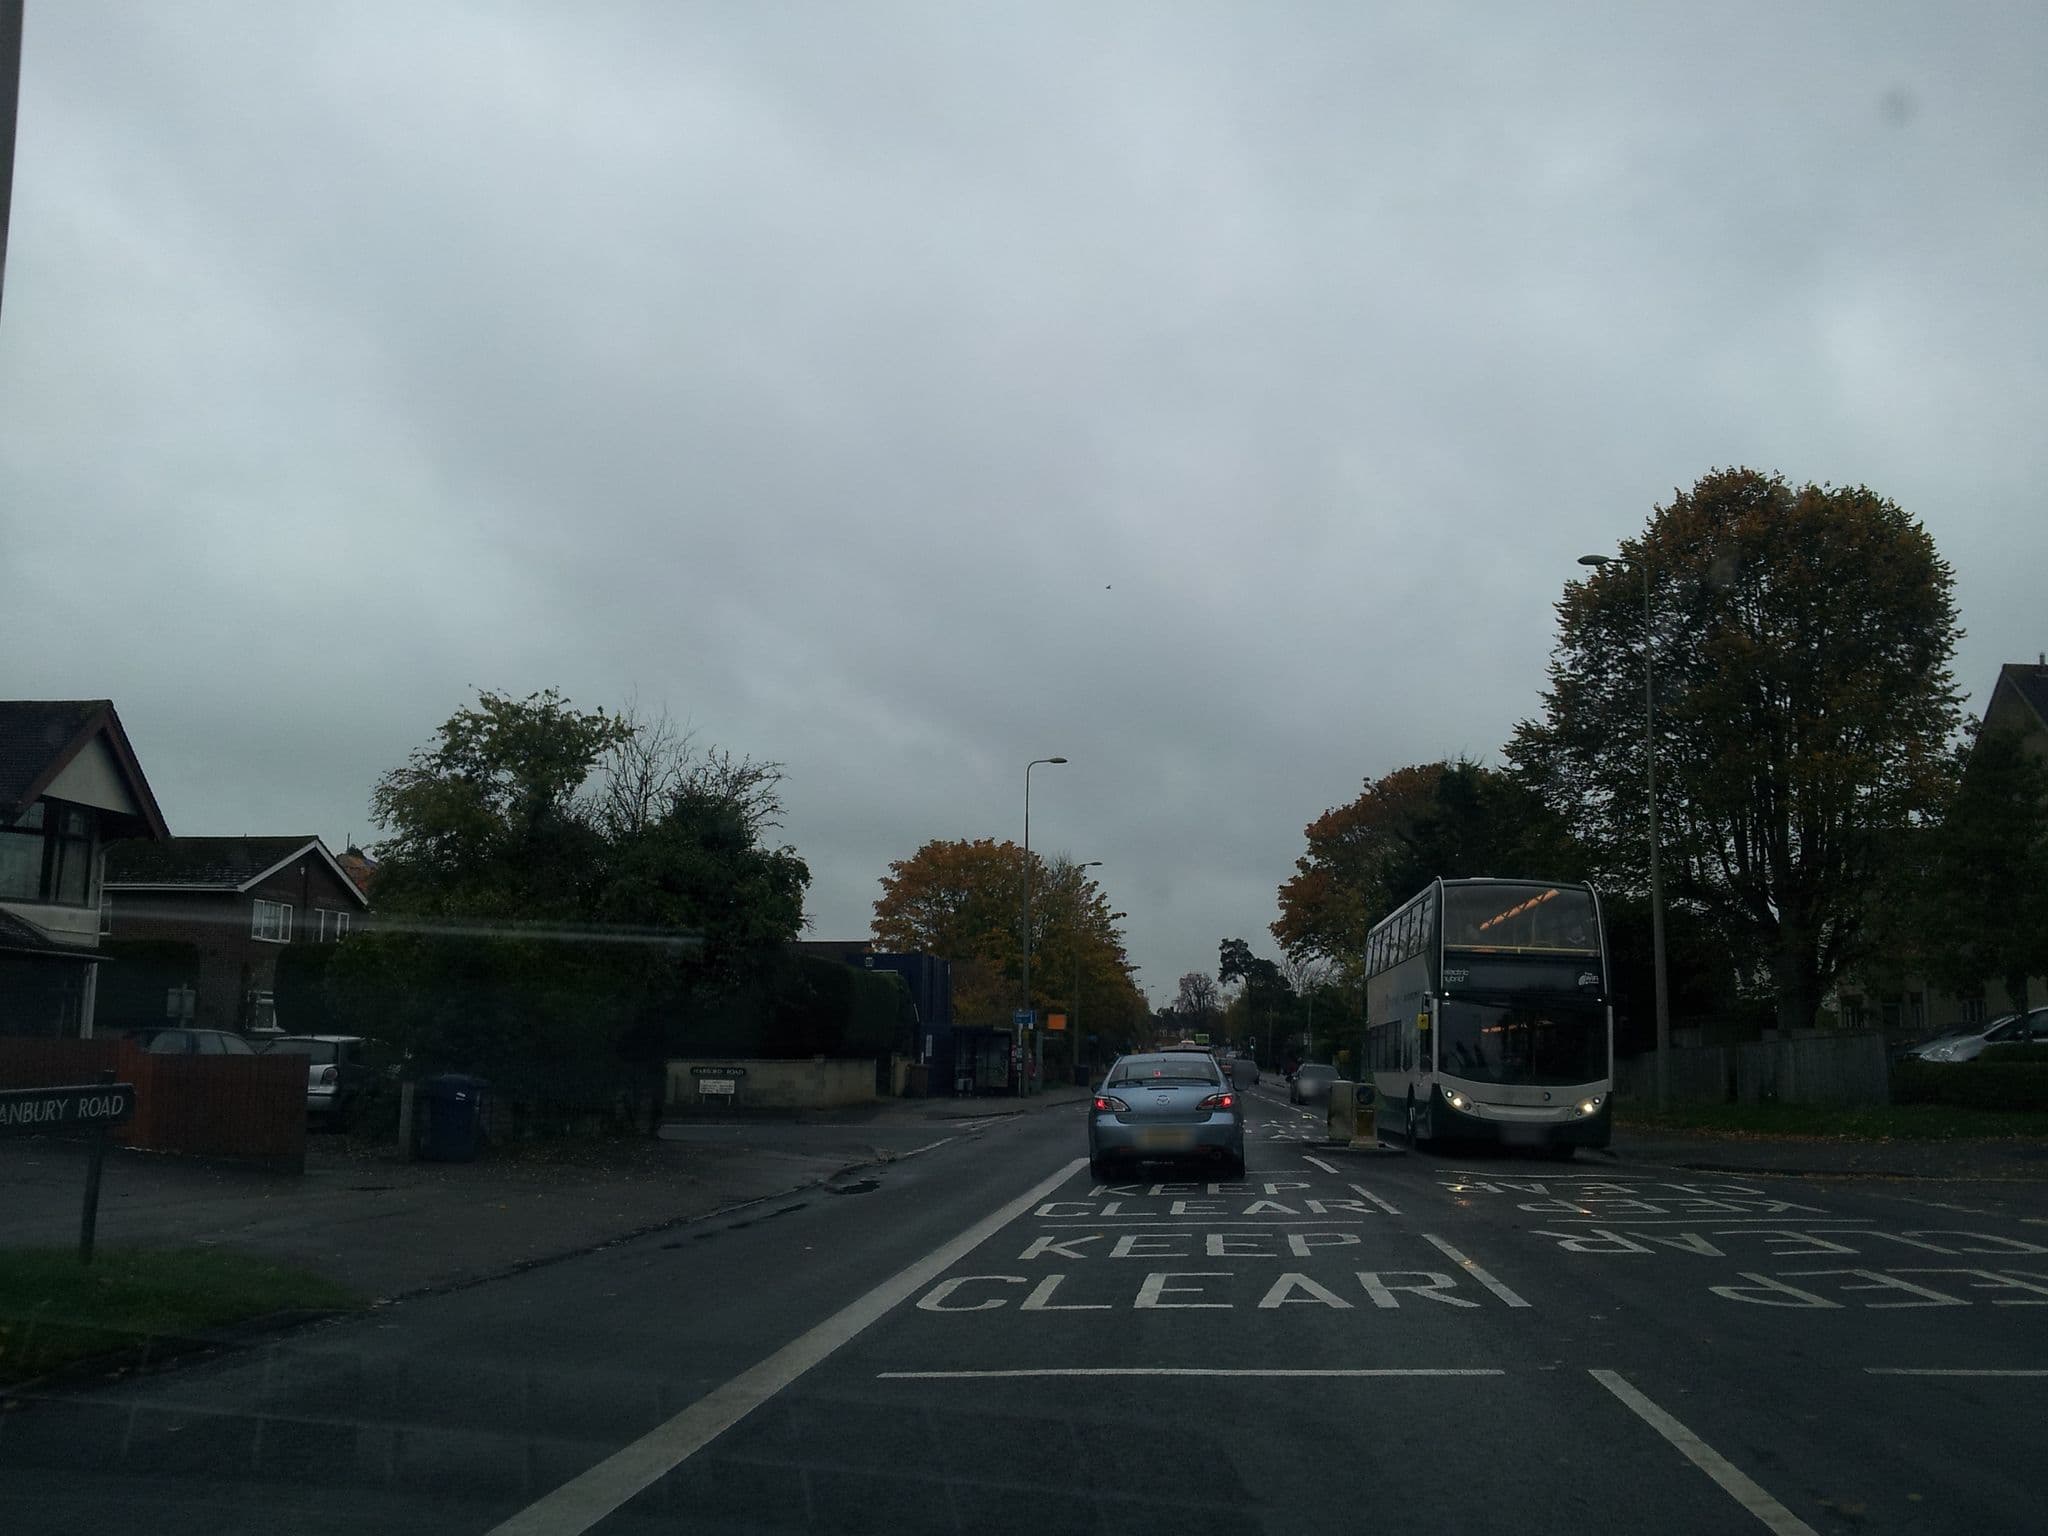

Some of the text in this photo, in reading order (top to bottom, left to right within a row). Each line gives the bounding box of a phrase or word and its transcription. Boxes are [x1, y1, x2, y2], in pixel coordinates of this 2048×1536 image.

[78, 1095, 124, 1118] ROAD
[1088, 1182, 1312, 1197] KEEP
[1034, 1198, 1376, 1218] CLEAR
[1018, 1232, 1362, 1260] KEEP
[916, 1271, 1481, 1311] CLEAR
[1708, 1268, 2048, 1309] EEP
